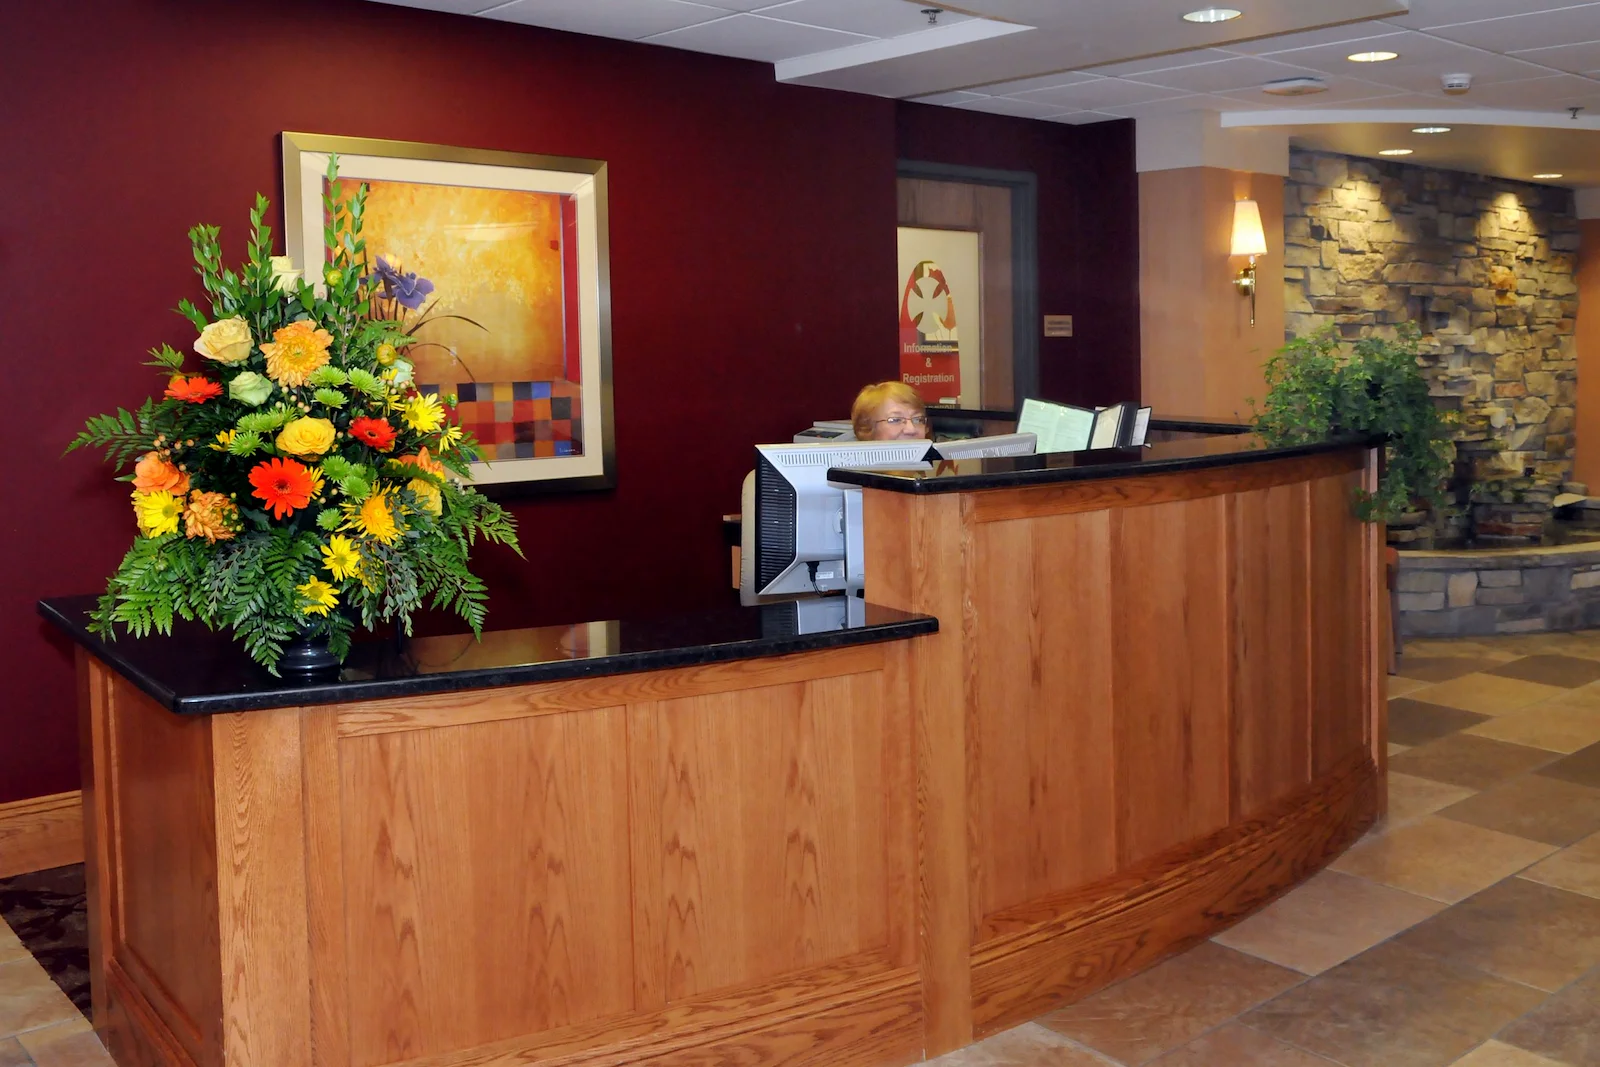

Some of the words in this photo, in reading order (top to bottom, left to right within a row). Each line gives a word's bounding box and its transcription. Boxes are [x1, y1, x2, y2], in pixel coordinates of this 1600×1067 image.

[904, 343, 952, 353] Information
[925, 357, 932, 367] &
[903, 373, 954, 385] Registration
